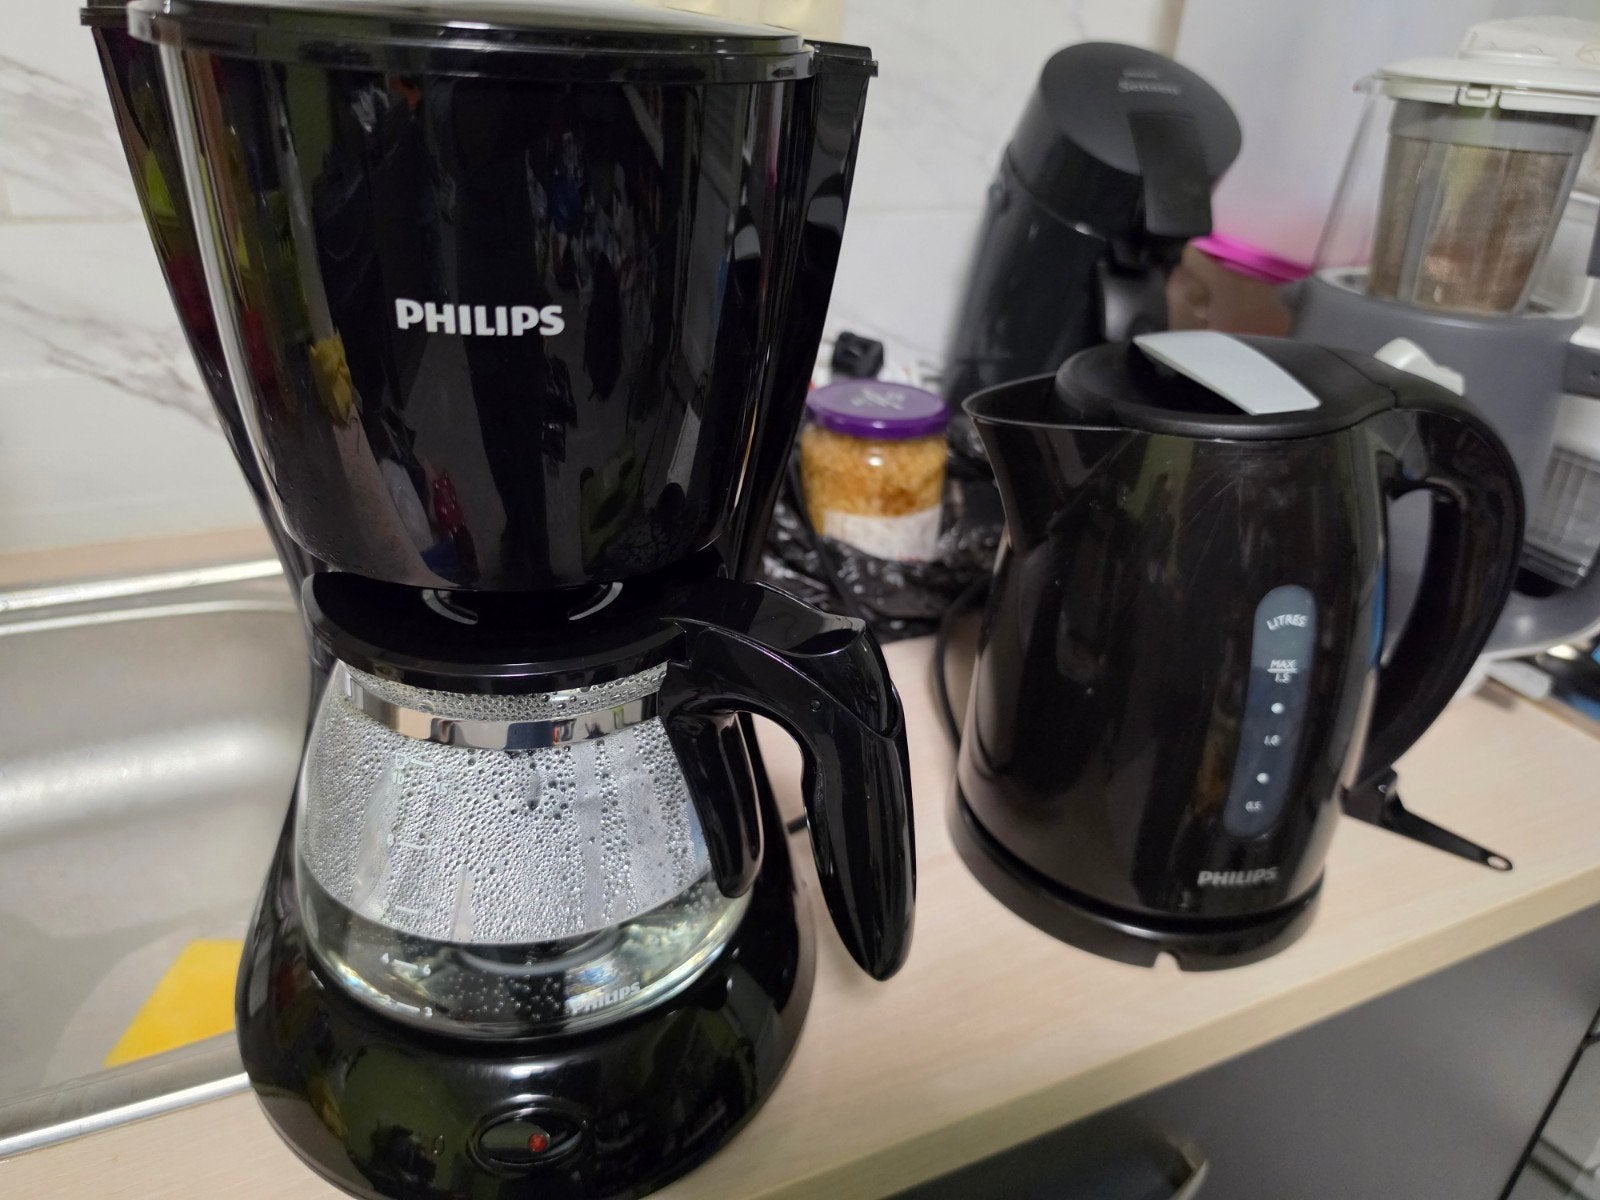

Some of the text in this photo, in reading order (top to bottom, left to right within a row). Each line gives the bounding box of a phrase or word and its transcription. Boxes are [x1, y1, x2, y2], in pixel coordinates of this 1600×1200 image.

[395, 298, 566, 337] PHILIPS
[1266, 613, 1308, 630] LITRES
[1197, 866, 1278, 887] PHILIPS
